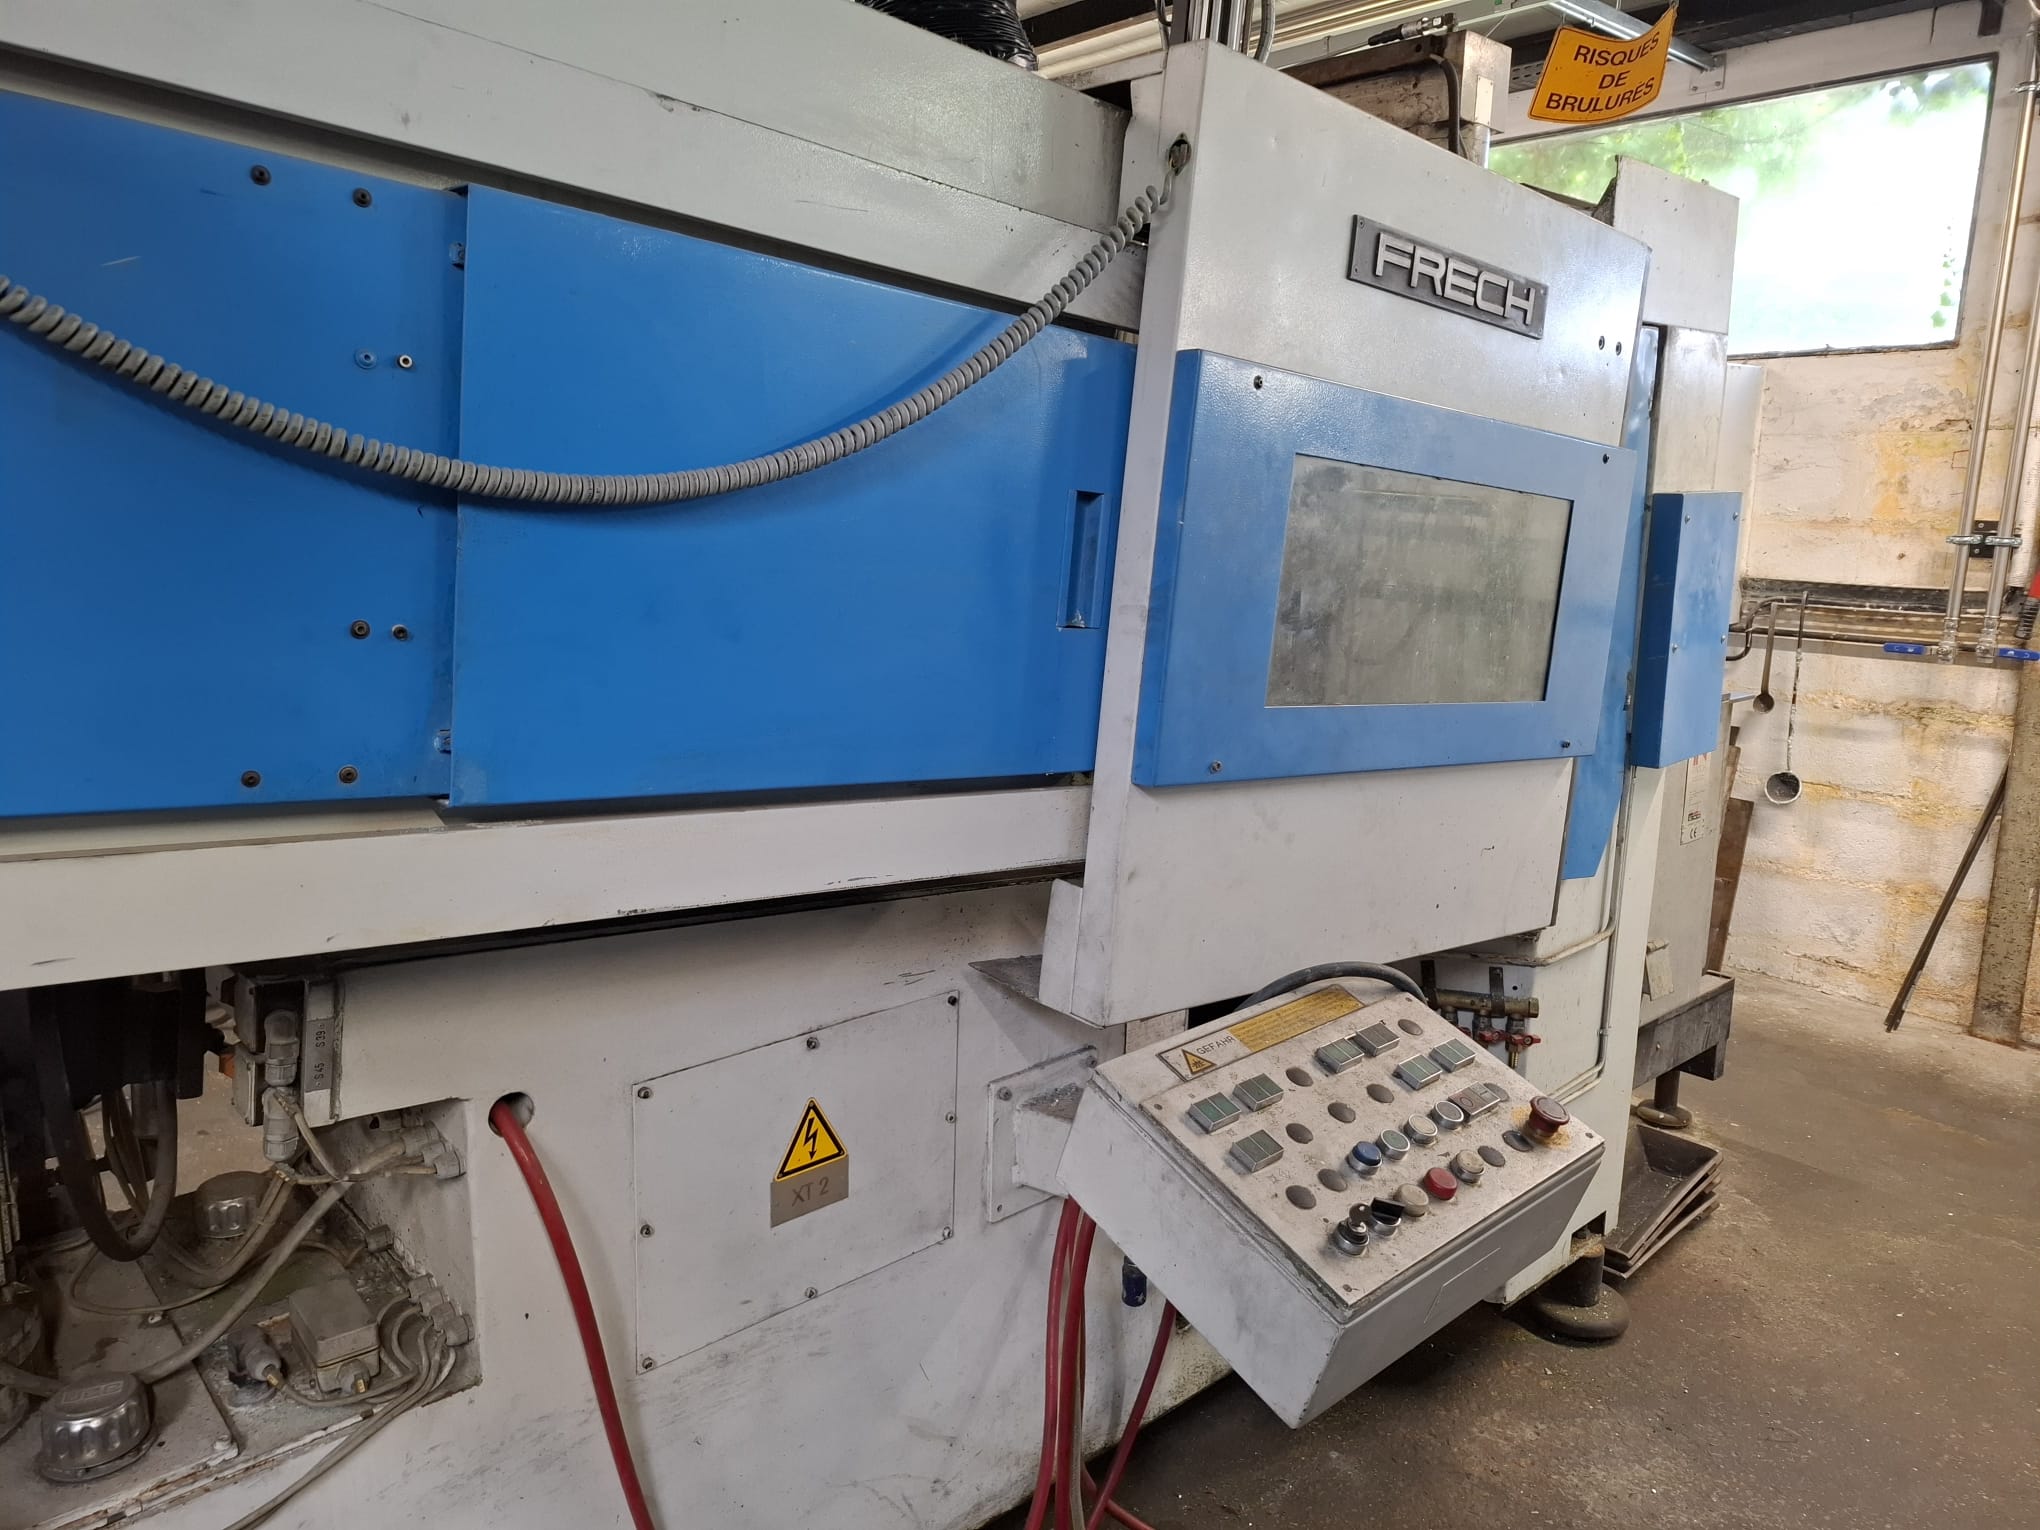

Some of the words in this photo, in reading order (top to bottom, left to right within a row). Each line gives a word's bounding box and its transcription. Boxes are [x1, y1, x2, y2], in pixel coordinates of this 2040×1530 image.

[1573, 31, 1660, 66] RISQUES
[1546, 77, 1655, 113] BRULURES
[1598, 70, 1630, 90] DE
[1375, 231, 1536, 325] FRECH
[1196, 1035, 1236, 1055] GEFAHR
[314, 1063, 325, 1080] S45
[791, 1182, 814, 1207] XT
[819, 1176, 829, 1196] 2
